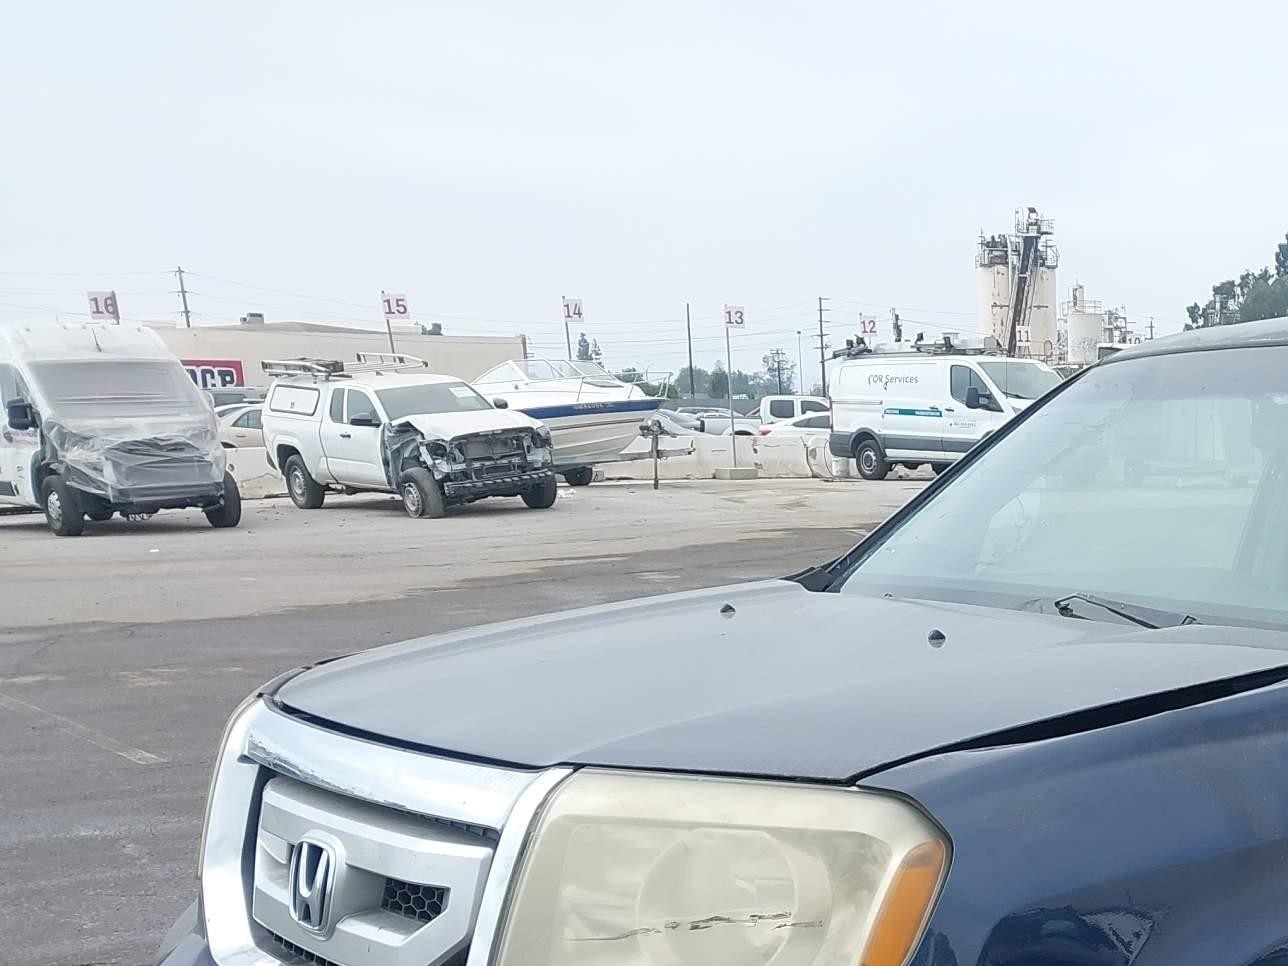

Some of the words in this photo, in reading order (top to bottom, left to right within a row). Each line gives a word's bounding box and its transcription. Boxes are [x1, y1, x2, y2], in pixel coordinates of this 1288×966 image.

[90, 297, 115, 314] 16
[384, 298, 408, 315] 15
[563, 303, 583, 319] 14
[725, 310, 744, 325] 13
[861, 320, 877, 334] 12
[1017, 330, 1030, 342] 11
[884, 374, 919, 385] Services
